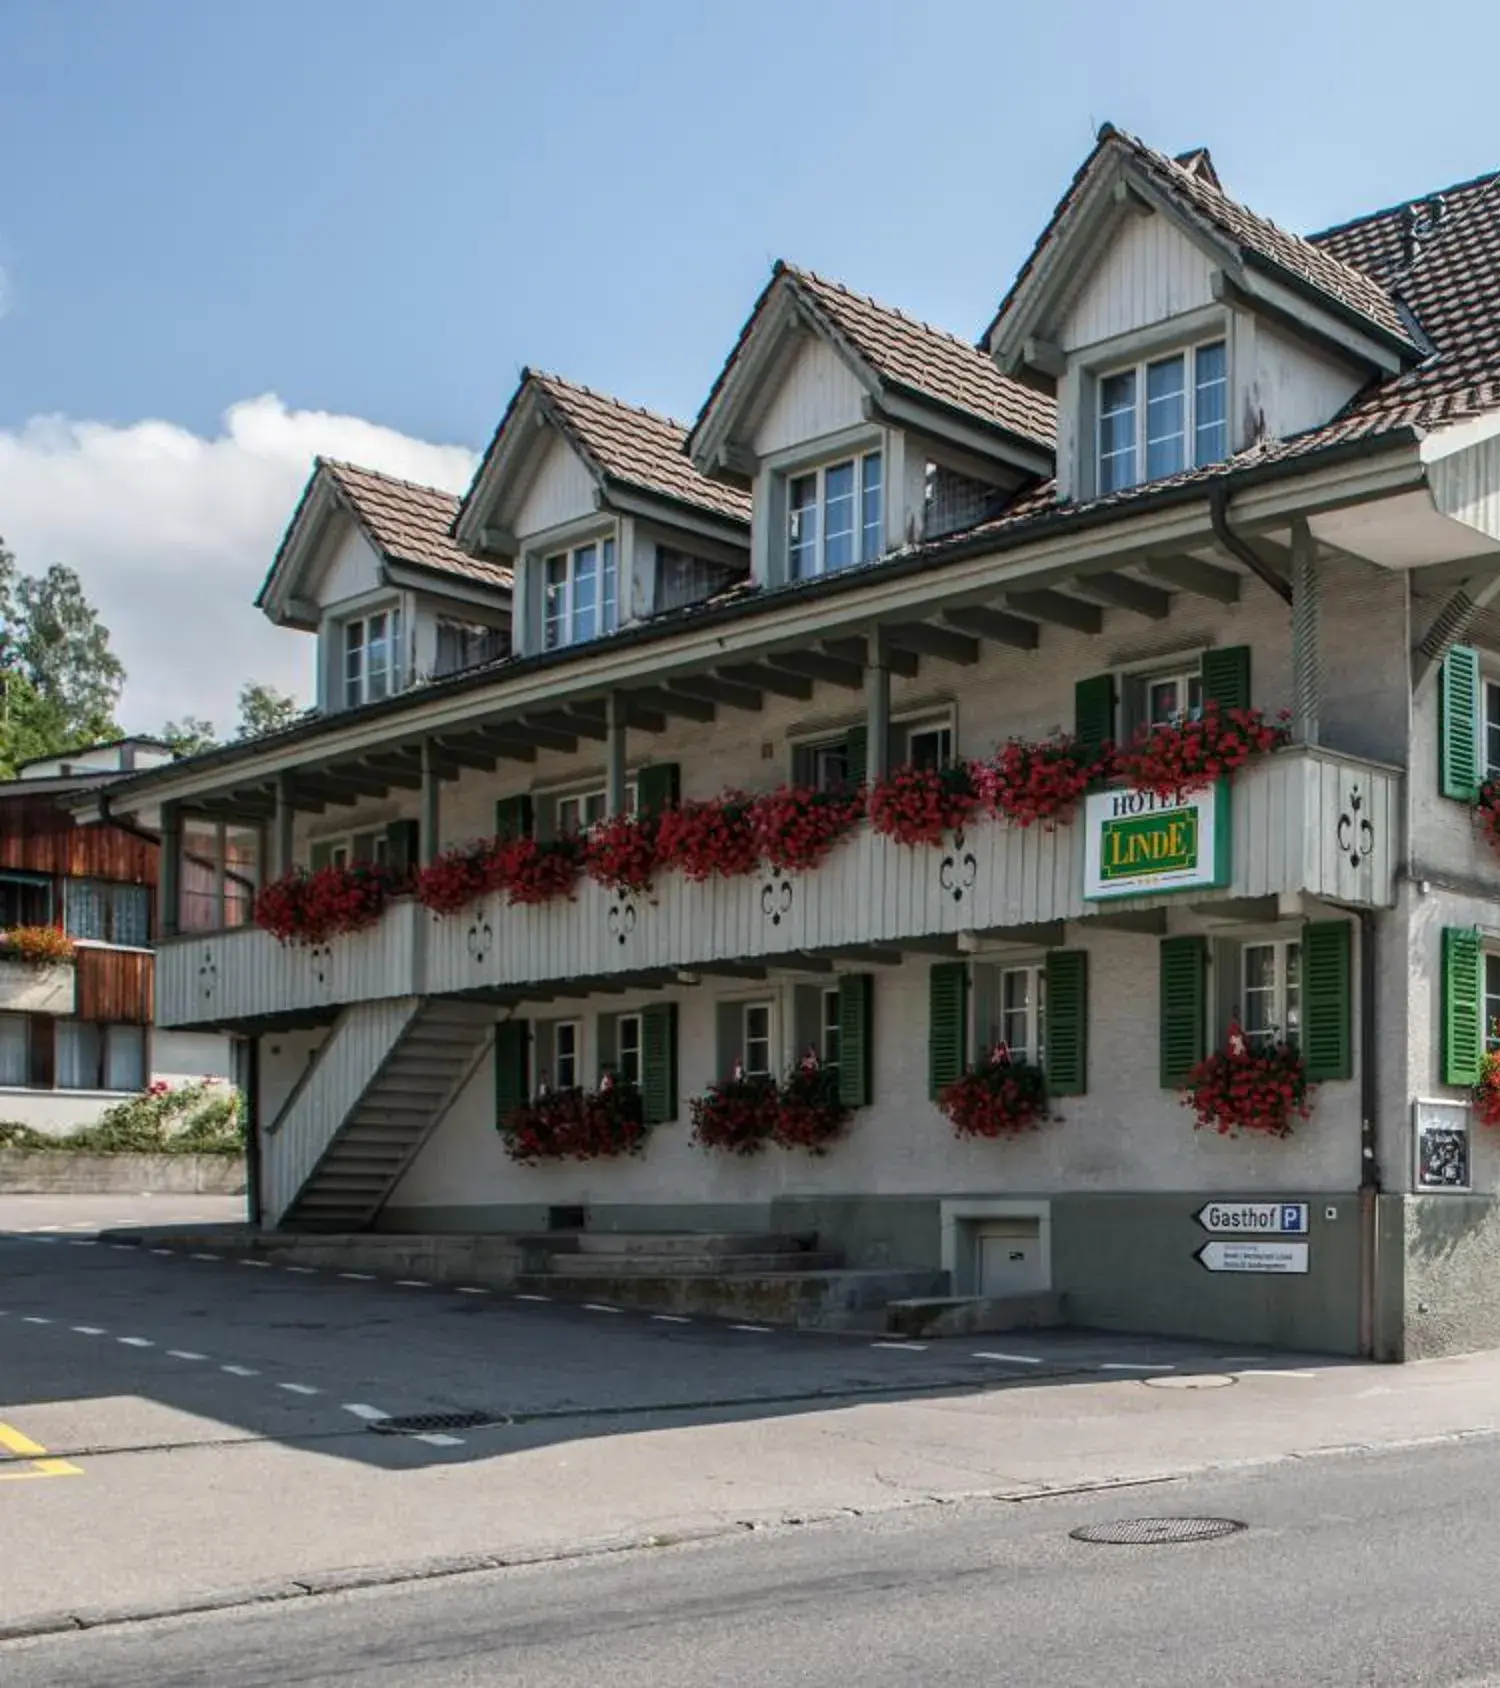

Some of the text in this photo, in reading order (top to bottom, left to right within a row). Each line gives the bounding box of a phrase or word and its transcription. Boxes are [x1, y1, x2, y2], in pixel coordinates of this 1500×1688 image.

[1112, 822, 1187, 865] LINDE
[1209, 1207, 1298, 1228] Gasthof P
